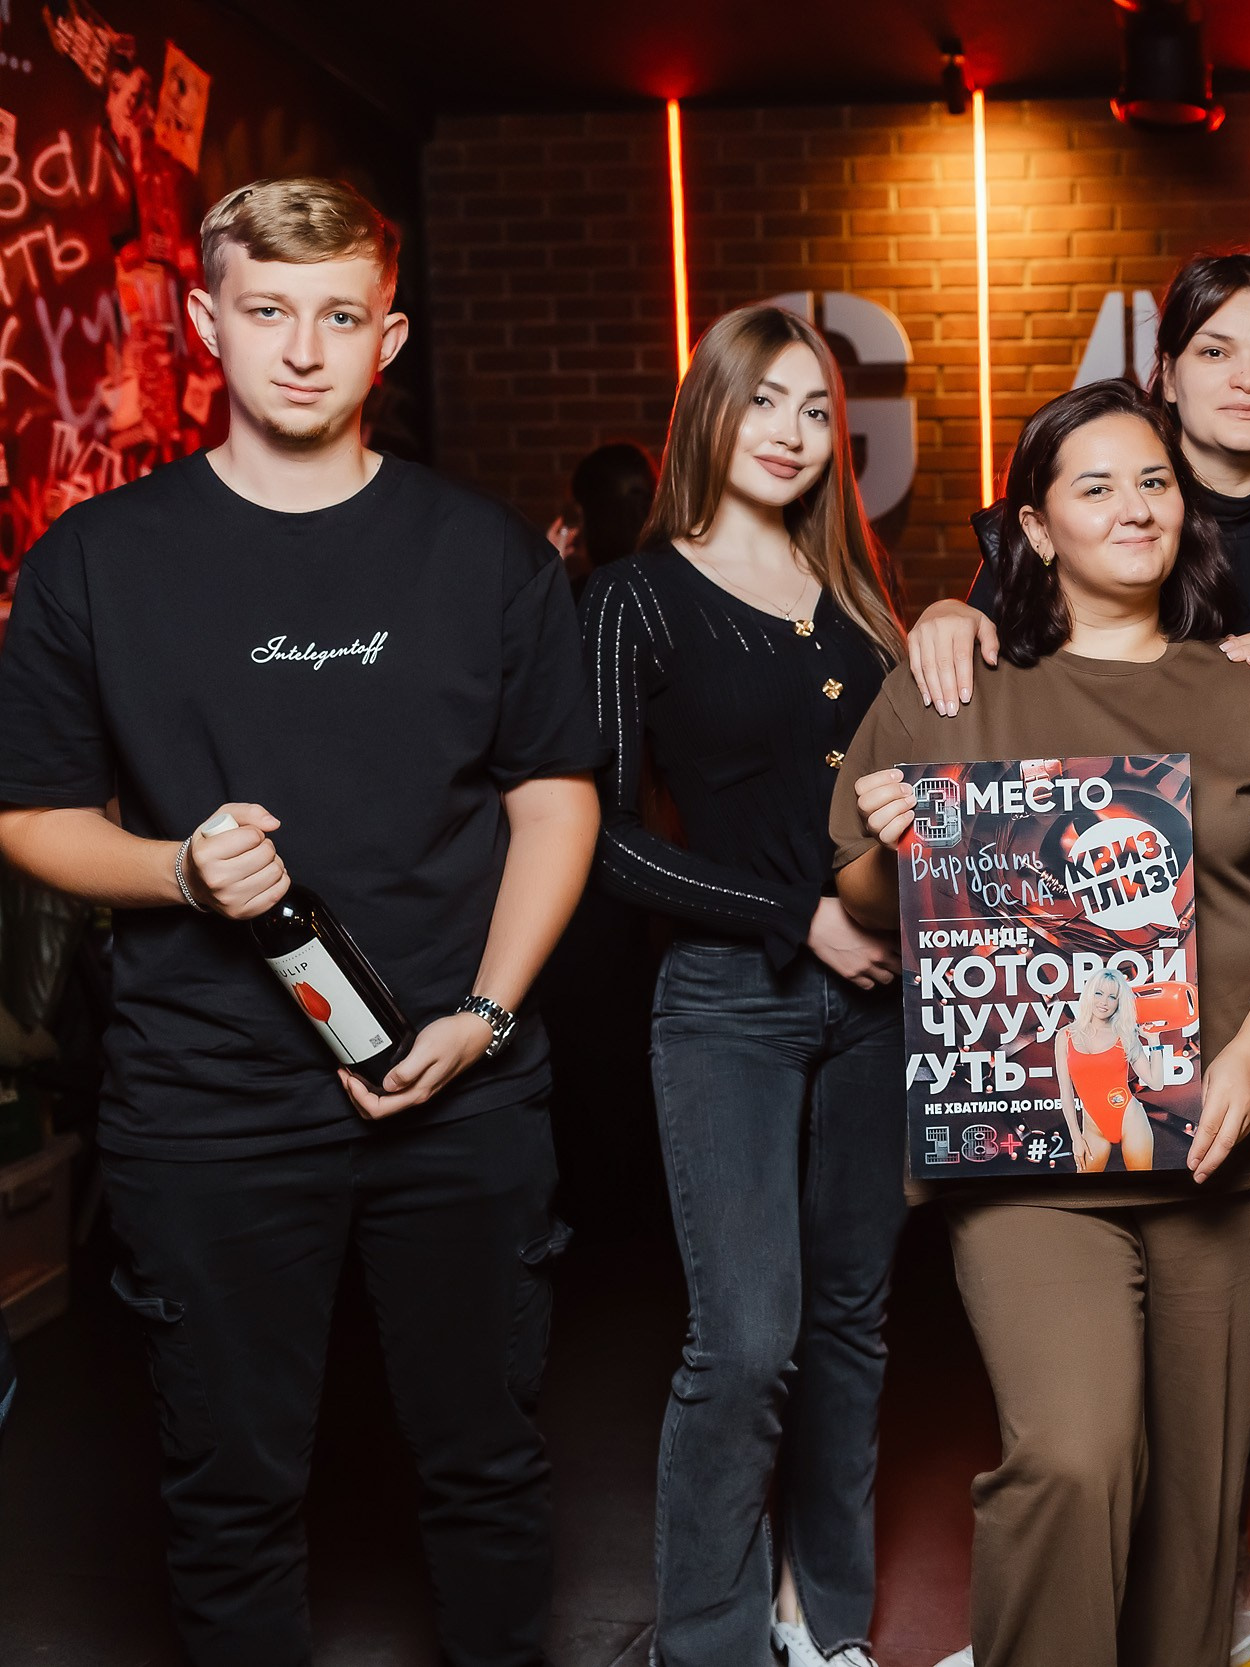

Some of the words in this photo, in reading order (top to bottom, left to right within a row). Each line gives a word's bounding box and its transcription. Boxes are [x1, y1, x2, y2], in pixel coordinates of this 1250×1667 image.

[251, 631, 388, 671] Intelegentoff
[912, 777, 962, 848] 3
[965, 777, 1113, 815] МЕСТО
[910, 842, 1044, 895] Вырубить
[1072, 860, 1179, 918] ПЛИЗ!
[918, 927, 1035, 949] КОМАНДЕ,
[920, 938, 1187, 999] КОТОРОЙ
[924, 1103, 943, 1115] НЕ
[944, 1100, 1008, 1115] ХВАТИЛО
[1010, 1099, 1032, 1114] ДО
[1034, 1098, 1083, 1111] ПОБД
[924, 1124, 1023, 1165] 18+
